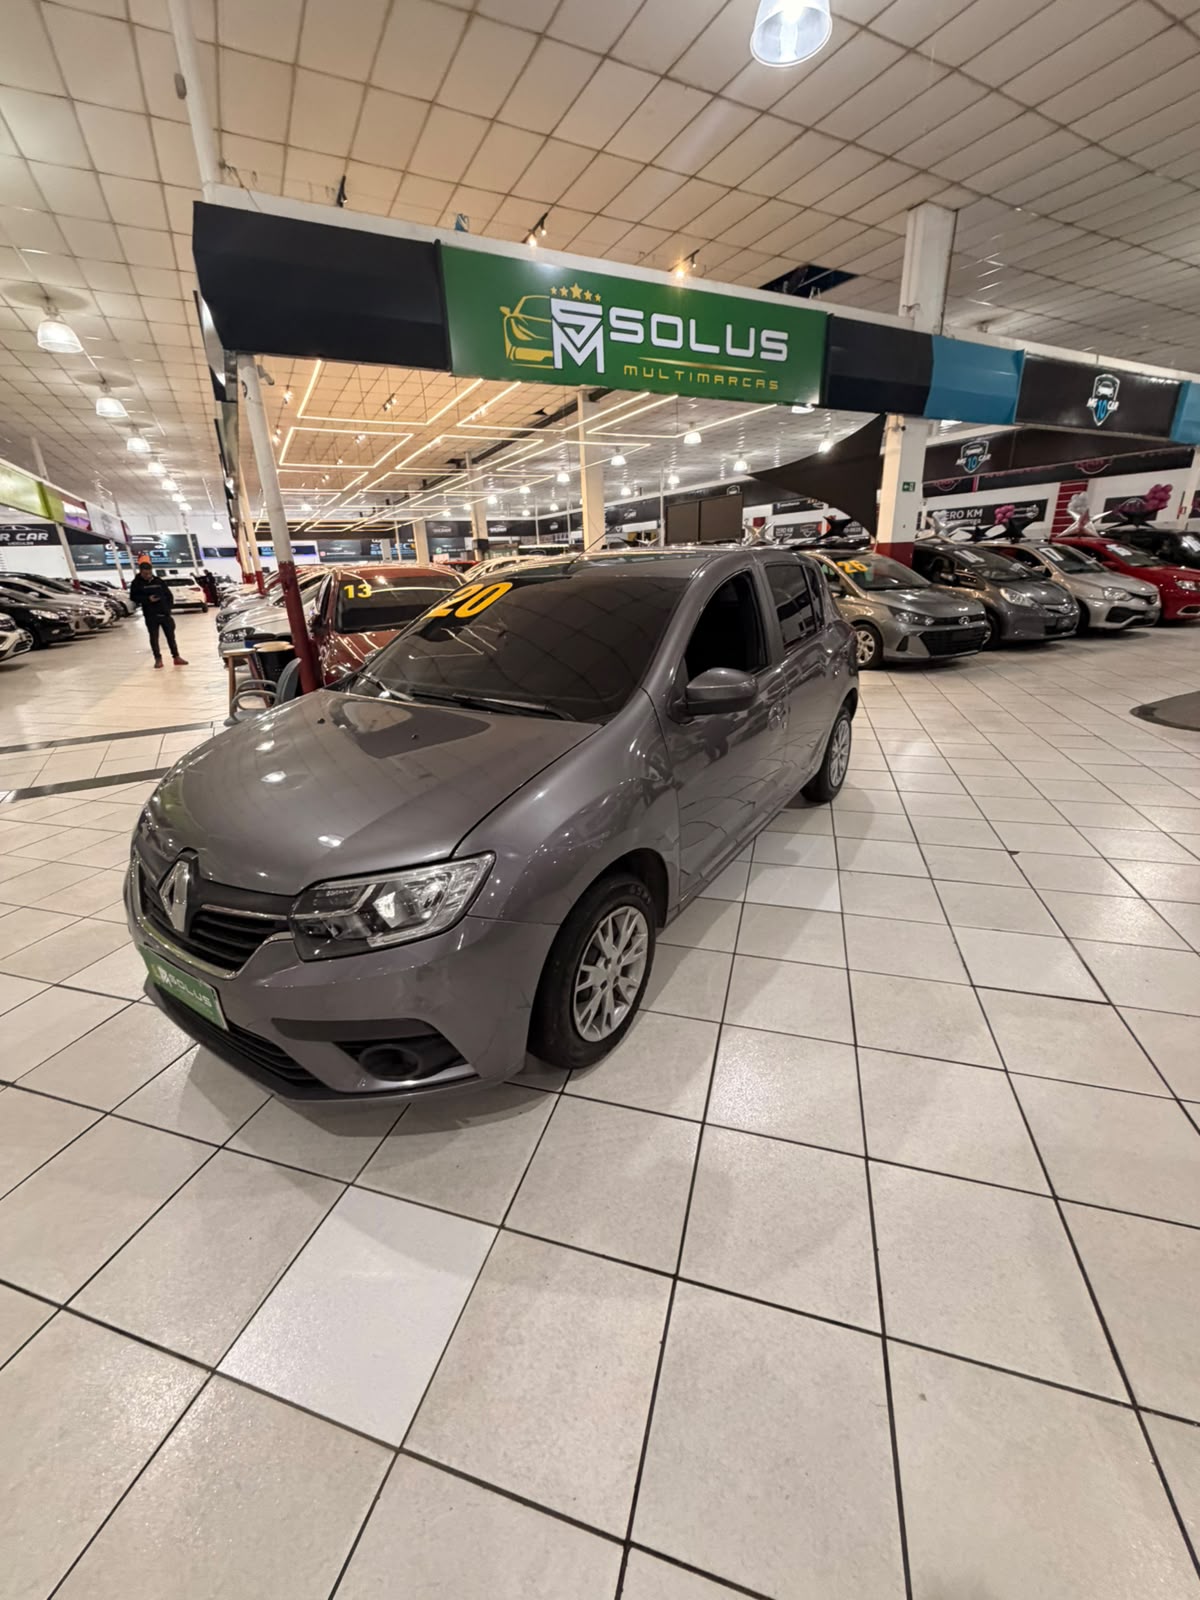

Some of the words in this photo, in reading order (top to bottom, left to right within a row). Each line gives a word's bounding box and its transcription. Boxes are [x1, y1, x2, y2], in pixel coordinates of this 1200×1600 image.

[608, 306, 789, 362] SOLUS
[623, 364, 779, 390] MULTIMARCAS
[1096, 399, 1107, 419] 10
[1107, 400, 1120, 411] CAR
[967, 455, 977, 470] 10
[945, 510, 965, 520] ERO
[966, 508, 983, 518] KM
[15, 532, 49, 541] CAR
[836, 560, 868, 574] 26
[343, 584, 373, 599] 13
[424, 582, 513, 618] 20
[168, 972, 212, 1008] SOLUS
